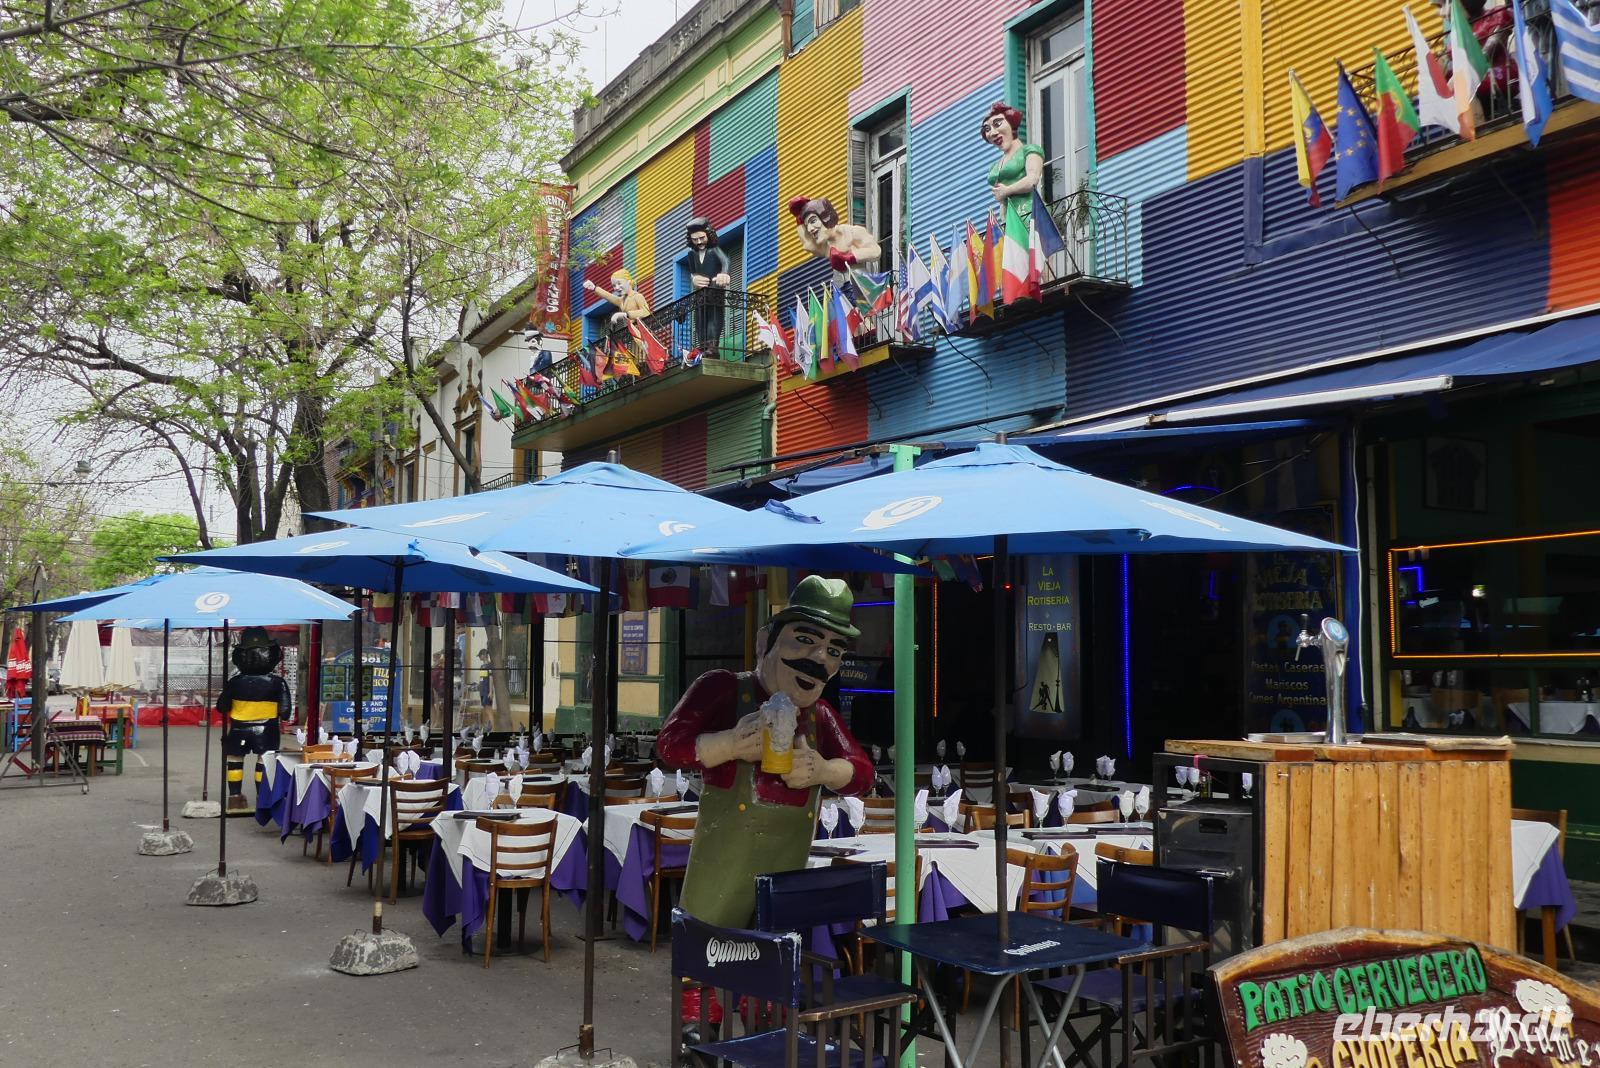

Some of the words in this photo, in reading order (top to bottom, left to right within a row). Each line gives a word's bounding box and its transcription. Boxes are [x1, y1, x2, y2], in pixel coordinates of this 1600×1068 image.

[1042, 566, 1054, 577] LA
[1038, 581, 1061, 591] VIEJA
[1265, 678, 1310, 690] Mariscos
[1277, 693, 1329, 706] Argentina
[706, 937, 761, 968] Quilmes
[1333, 946, 1488, 1015] CERVECERO
